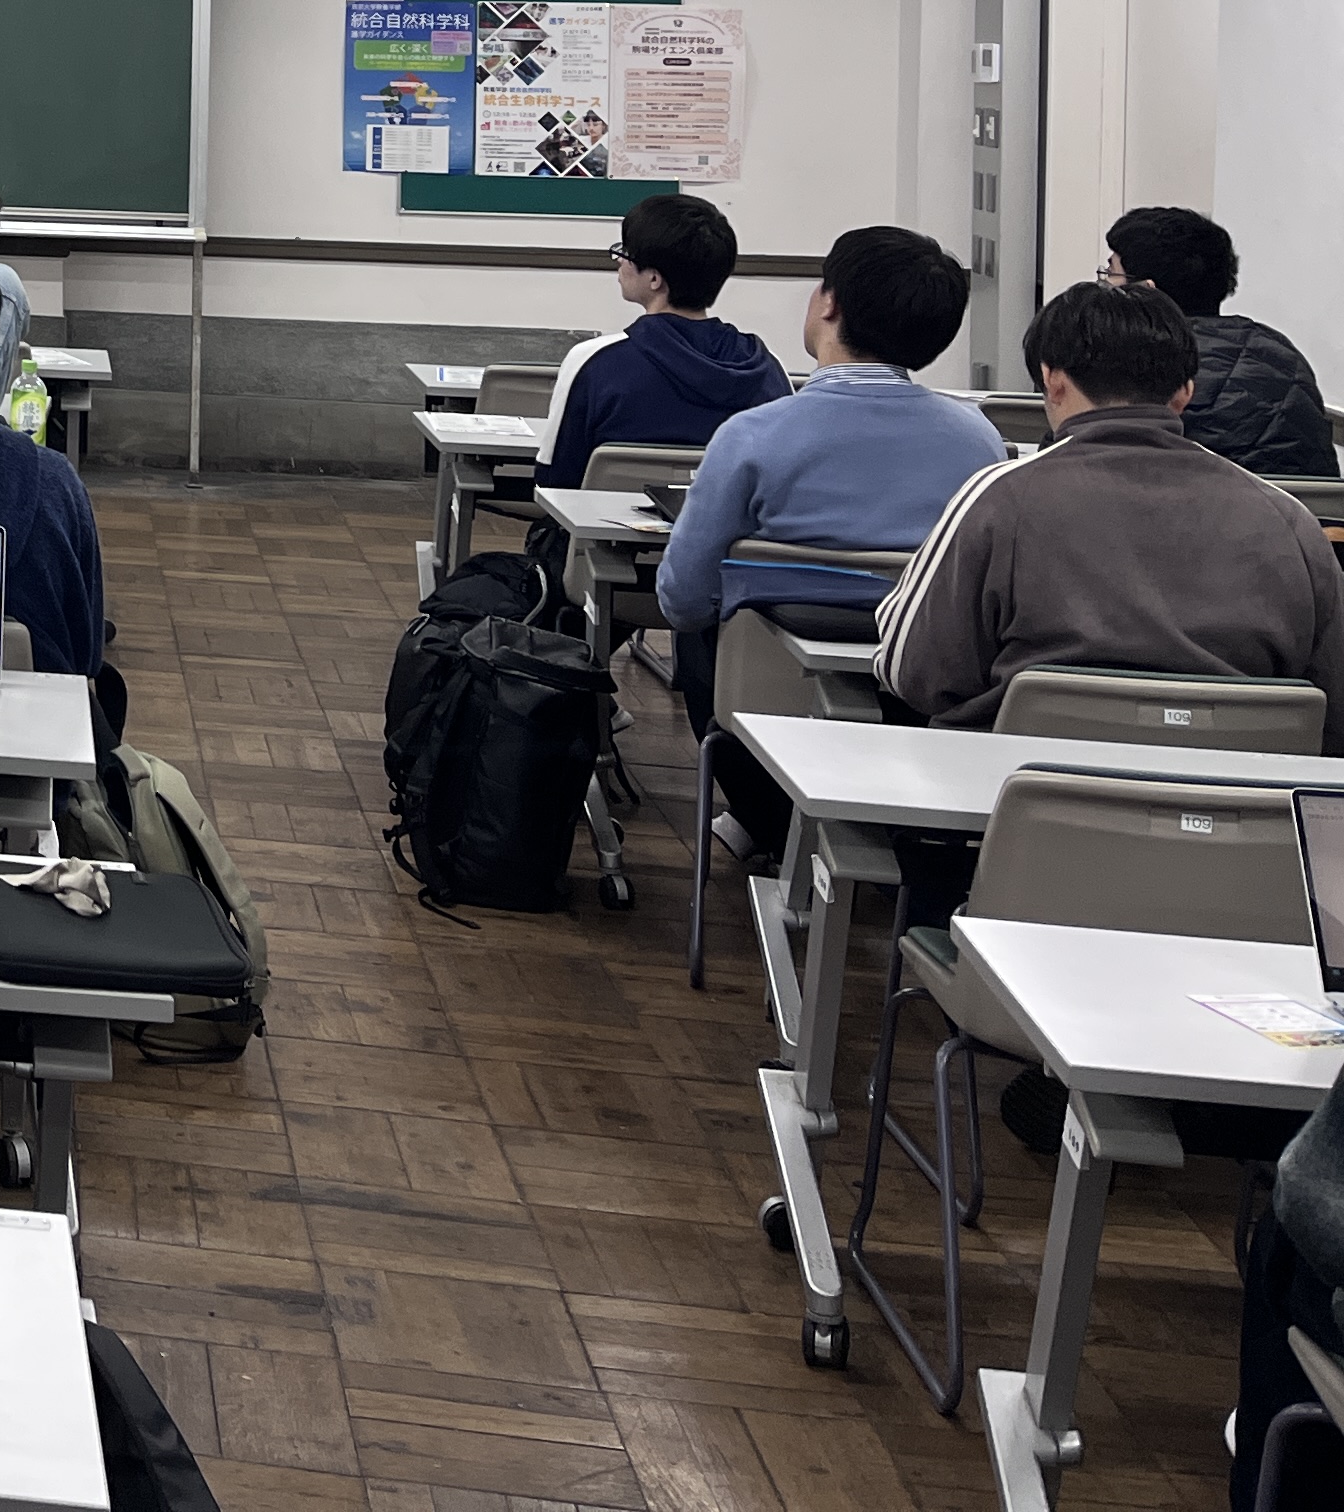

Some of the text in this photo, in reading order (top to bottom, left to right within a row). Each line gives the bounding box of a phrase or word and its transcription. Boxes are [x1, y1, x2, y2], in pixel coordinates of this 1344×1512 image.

[351, 12, 470, 30] 統合自然科学科
[641, 36, 714, 45] 統合自然科学科の
[483, 94, 601, 108] 統合生命科学コース
[1167, 711, 1191, 722] 109
[1185, 816, 1211, 829] 109
